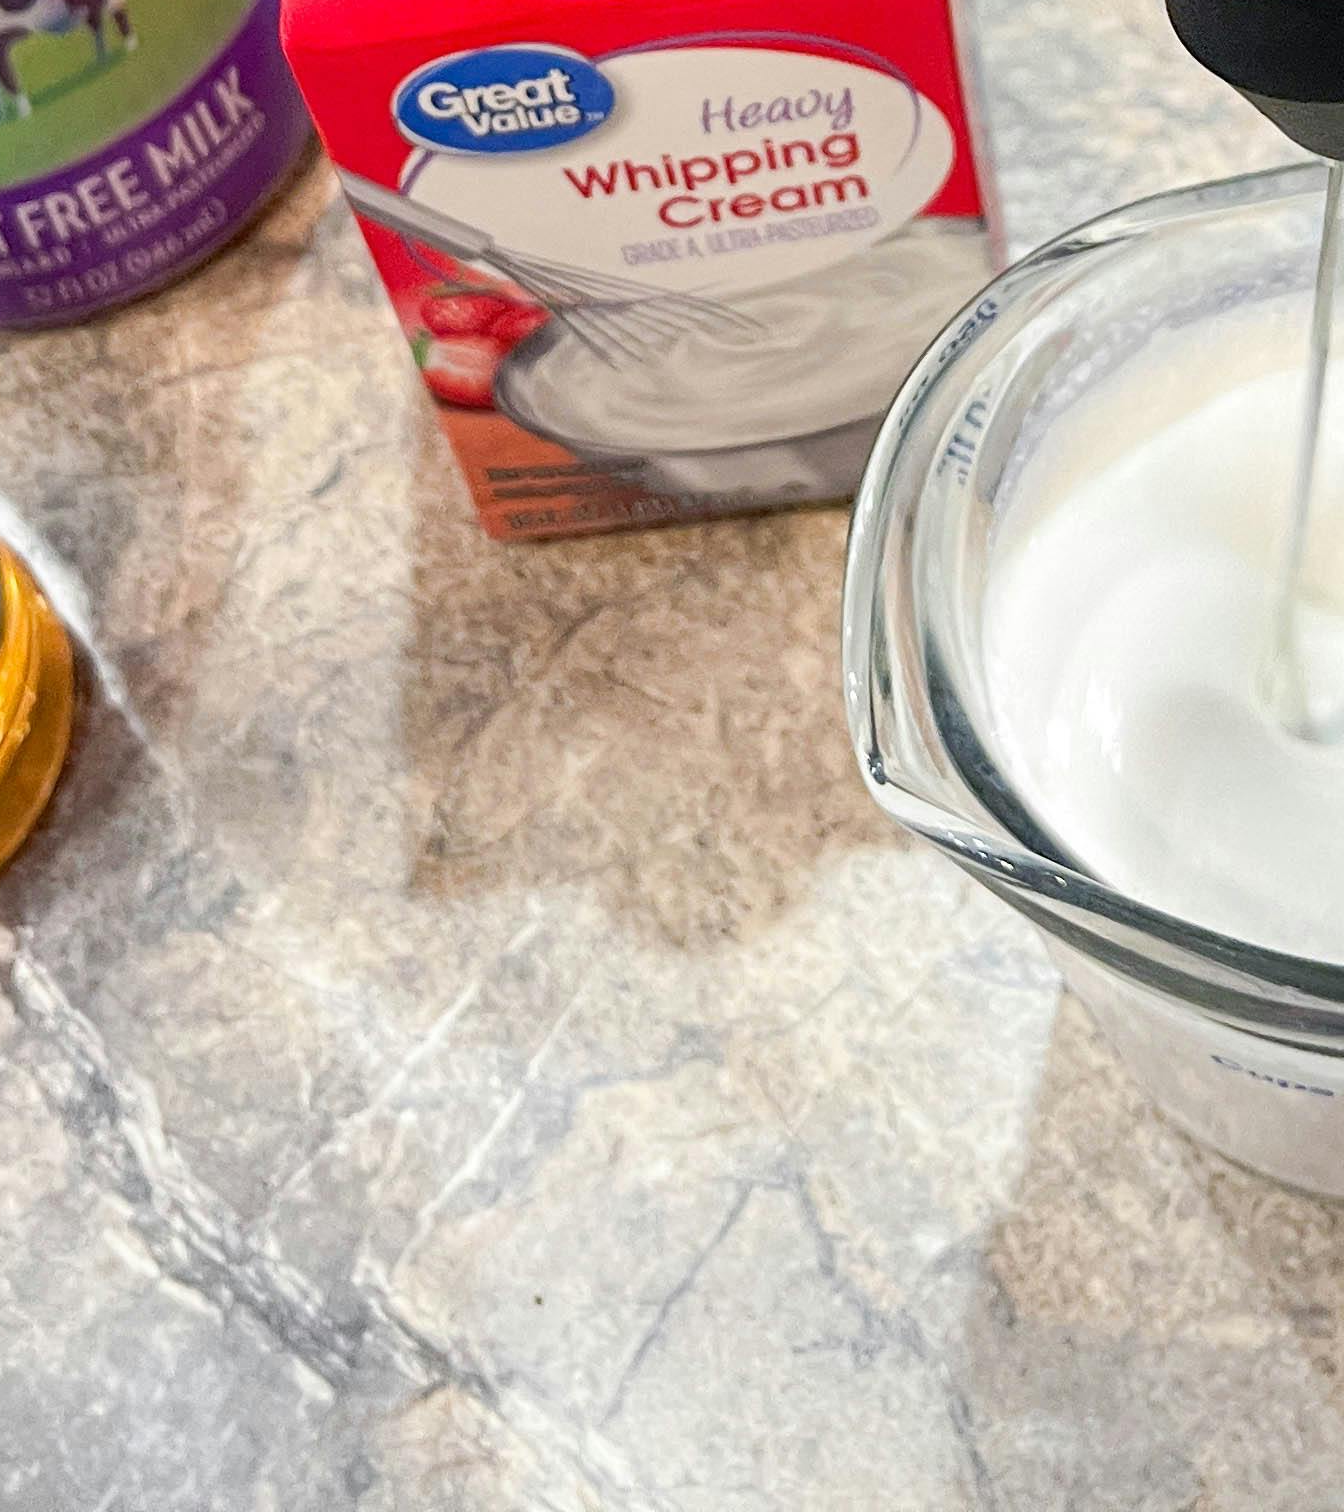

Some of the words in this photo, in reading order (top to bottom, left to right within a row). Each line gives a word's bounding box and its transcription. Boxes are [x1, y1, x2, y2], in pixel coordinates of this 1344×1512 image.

[418, 67, 576, 119] Great
[701, 87, 854, 134] Heavy
[462, 104, 581, 136] Value
[14, 157, 150, 250] FREE
[144, 66, 256, 186] MILK
[562, 133, 860, 199] Whipping
[659, 175, 869, 228] Cream
